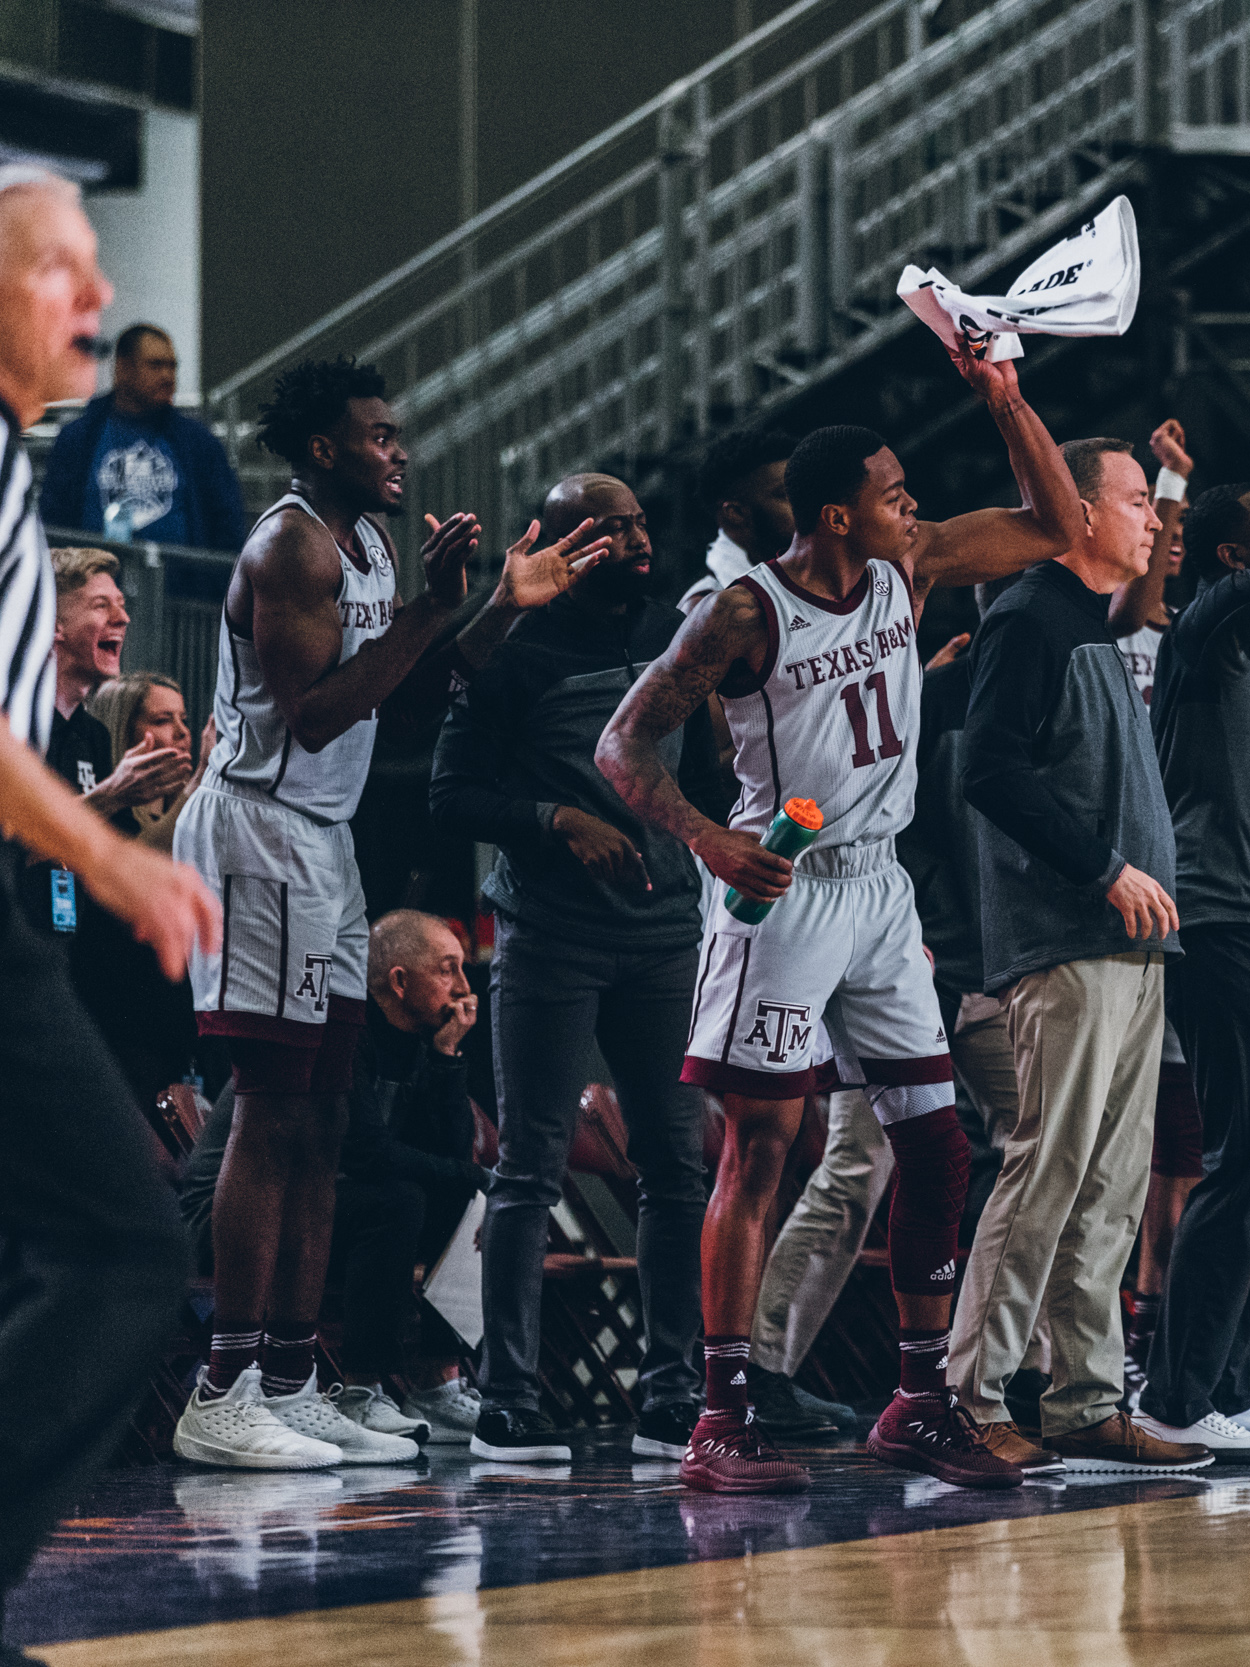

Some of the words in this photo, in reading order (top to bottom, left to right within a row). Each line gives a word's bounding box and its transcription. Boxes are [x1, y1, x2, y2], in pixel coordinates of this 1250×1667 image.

[786, 638, 875, 690] TEXAS
[875, 615, 912, 659] A&M
[840, 671, 902, 768] 11
